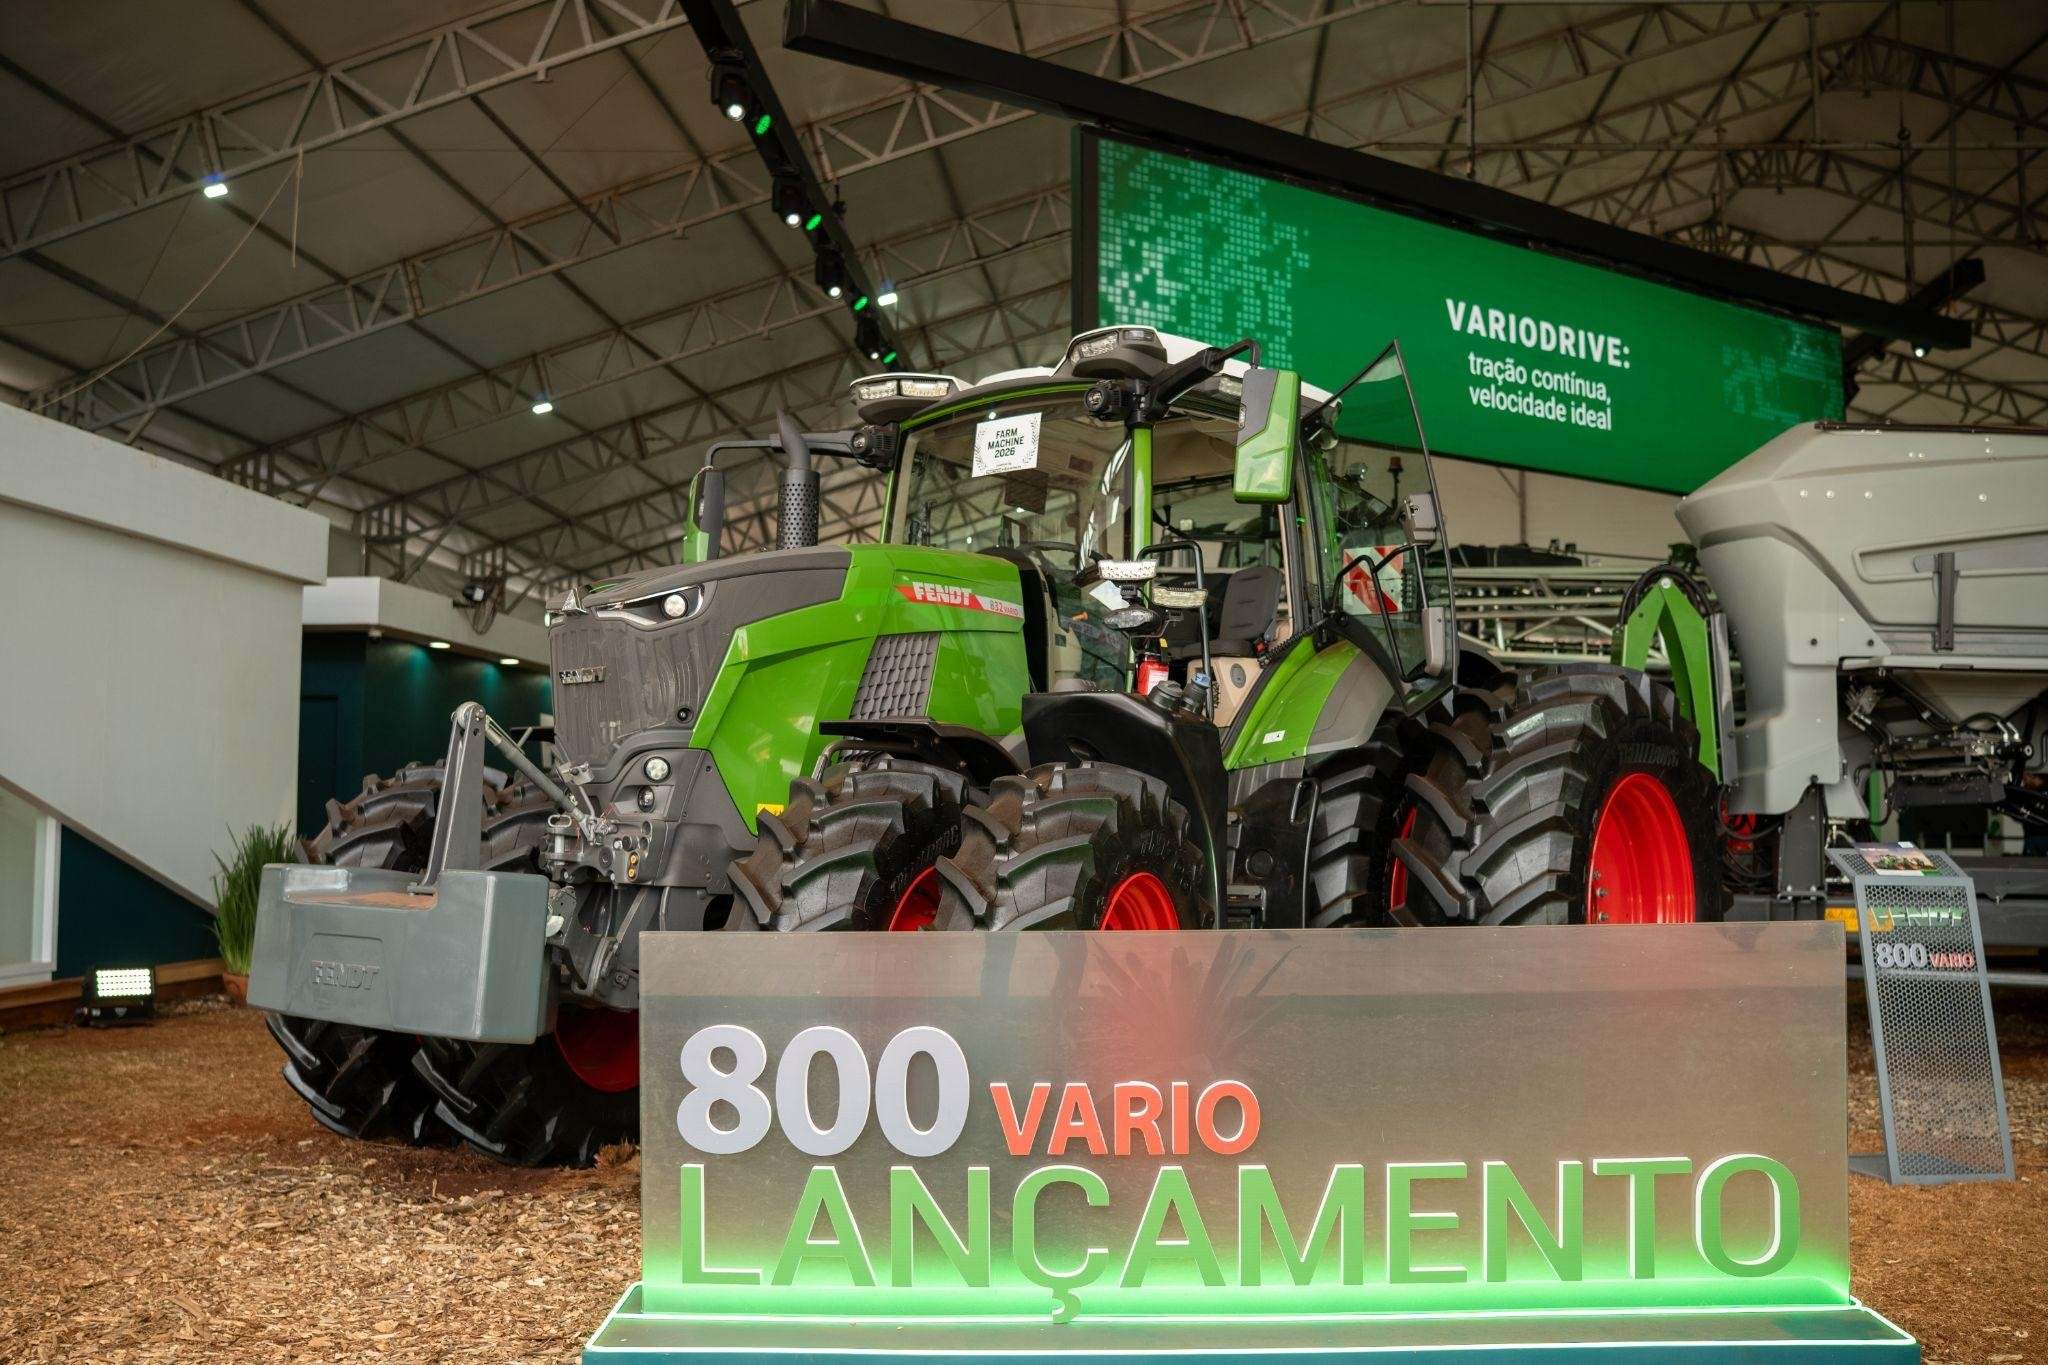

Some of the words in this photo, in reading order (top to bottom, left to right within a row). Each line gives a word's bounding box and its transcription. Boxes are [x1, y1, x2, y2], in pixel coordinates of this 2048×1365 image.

[1445, 297, 1631, 370] VARIODRIVE:
[1467, 351, 1528, 386] tração
[1531, 371, 1612, 406] contínua,
[1468, 383, 1567, 423] velocidade
[1570, 400, 1612, 431] ideal
[987, 435, 1025, 451] MACHINE
[995, 427, 1019, 440] FARM
[994, 447, 1017, 459] 2026
[912, 581, 973, 606] FENDT
[1876, 942, 1928, 969] 800
[1929, 950, 1976, 969] VARIO
[311, 959, 381, 991] FENDT
[675, 1024, 970, 1157] 800
[989, 1079, 1262, 1157] VARIO
[679, 1152, 1801, 1325] LANÇAMENTO
